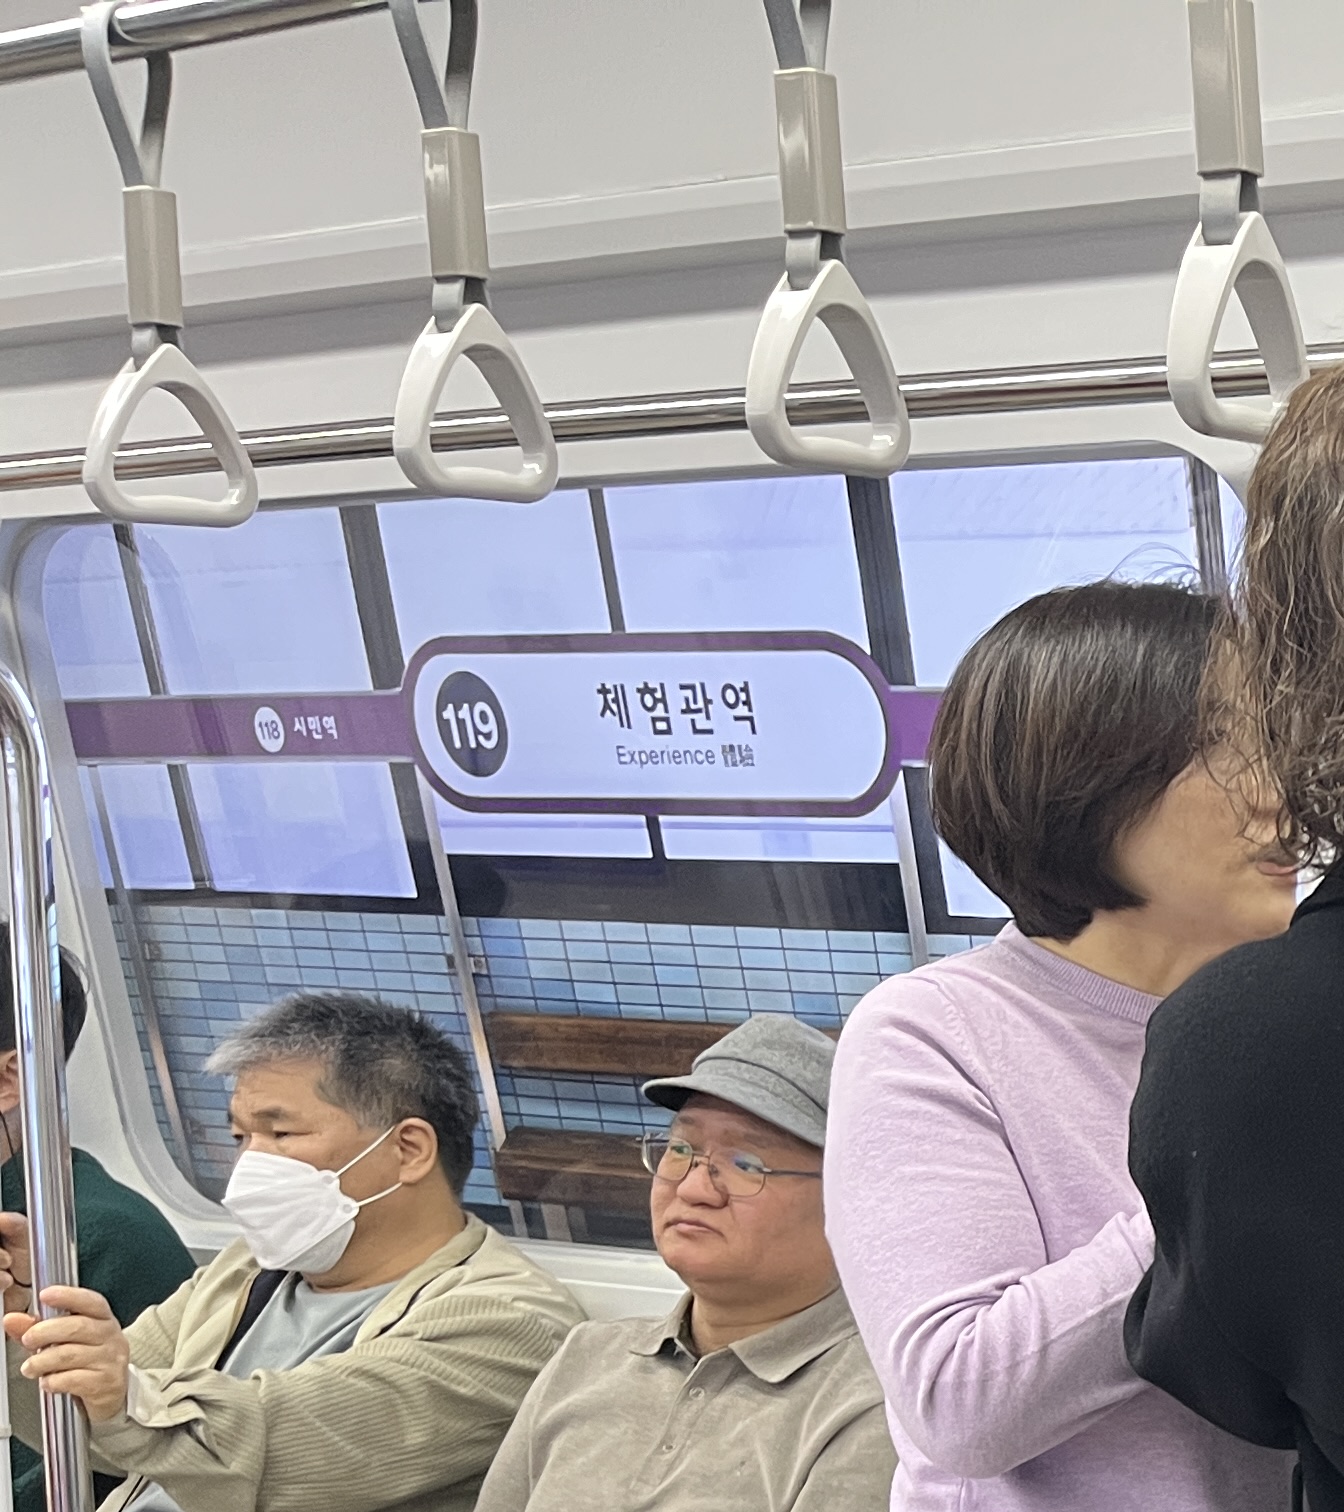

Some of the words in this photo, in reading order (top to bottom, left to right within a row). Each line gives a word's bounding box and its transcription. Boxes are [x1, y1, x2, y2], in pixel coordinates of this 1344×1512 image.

[442, 701, 499, 750] 119
[596, 680, 757, 735] 체험관역
[258, 720, 281, 740] 118
[293, 714, 339, 740] 시민역
[615, 744, 716, 768] Experience
